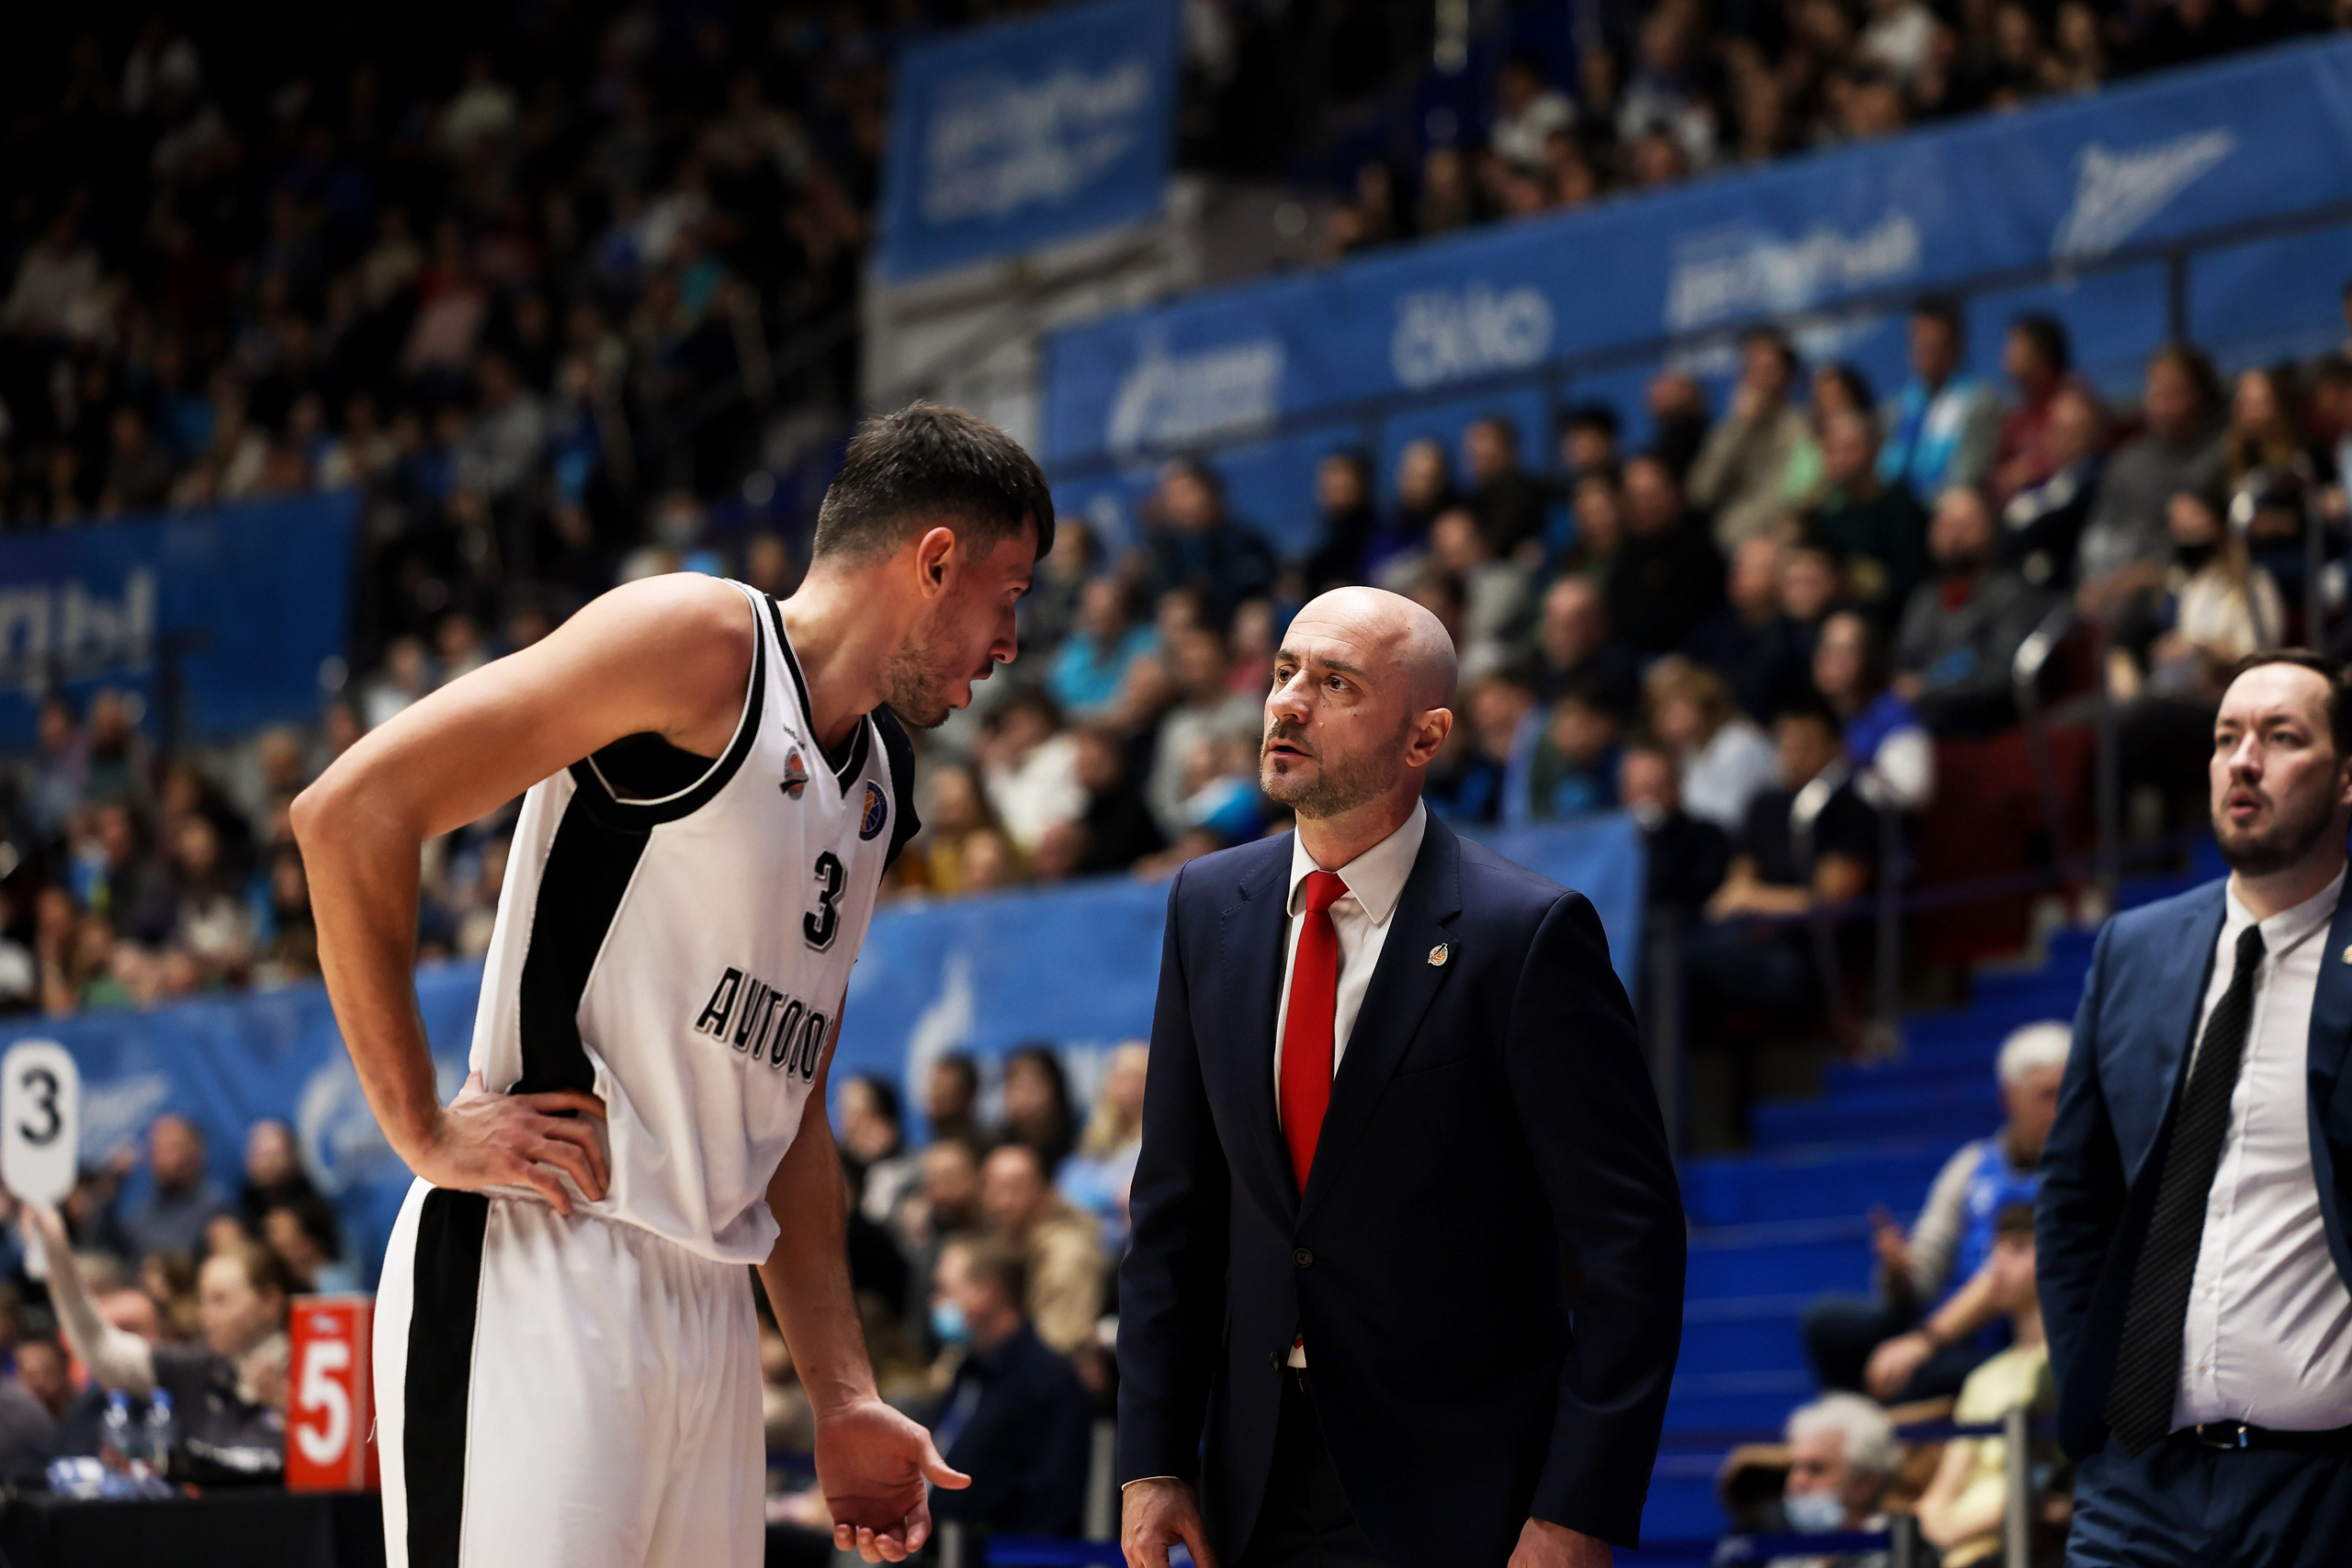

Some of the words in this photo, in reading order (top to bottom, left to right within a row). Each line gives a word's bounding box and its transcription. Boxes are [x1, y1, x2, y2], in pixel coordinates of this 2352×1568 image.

[803, 850, 847, 953] 3
[19, 1066, 62, 1145] 3
[296, 1338, 352, 1465] 5
